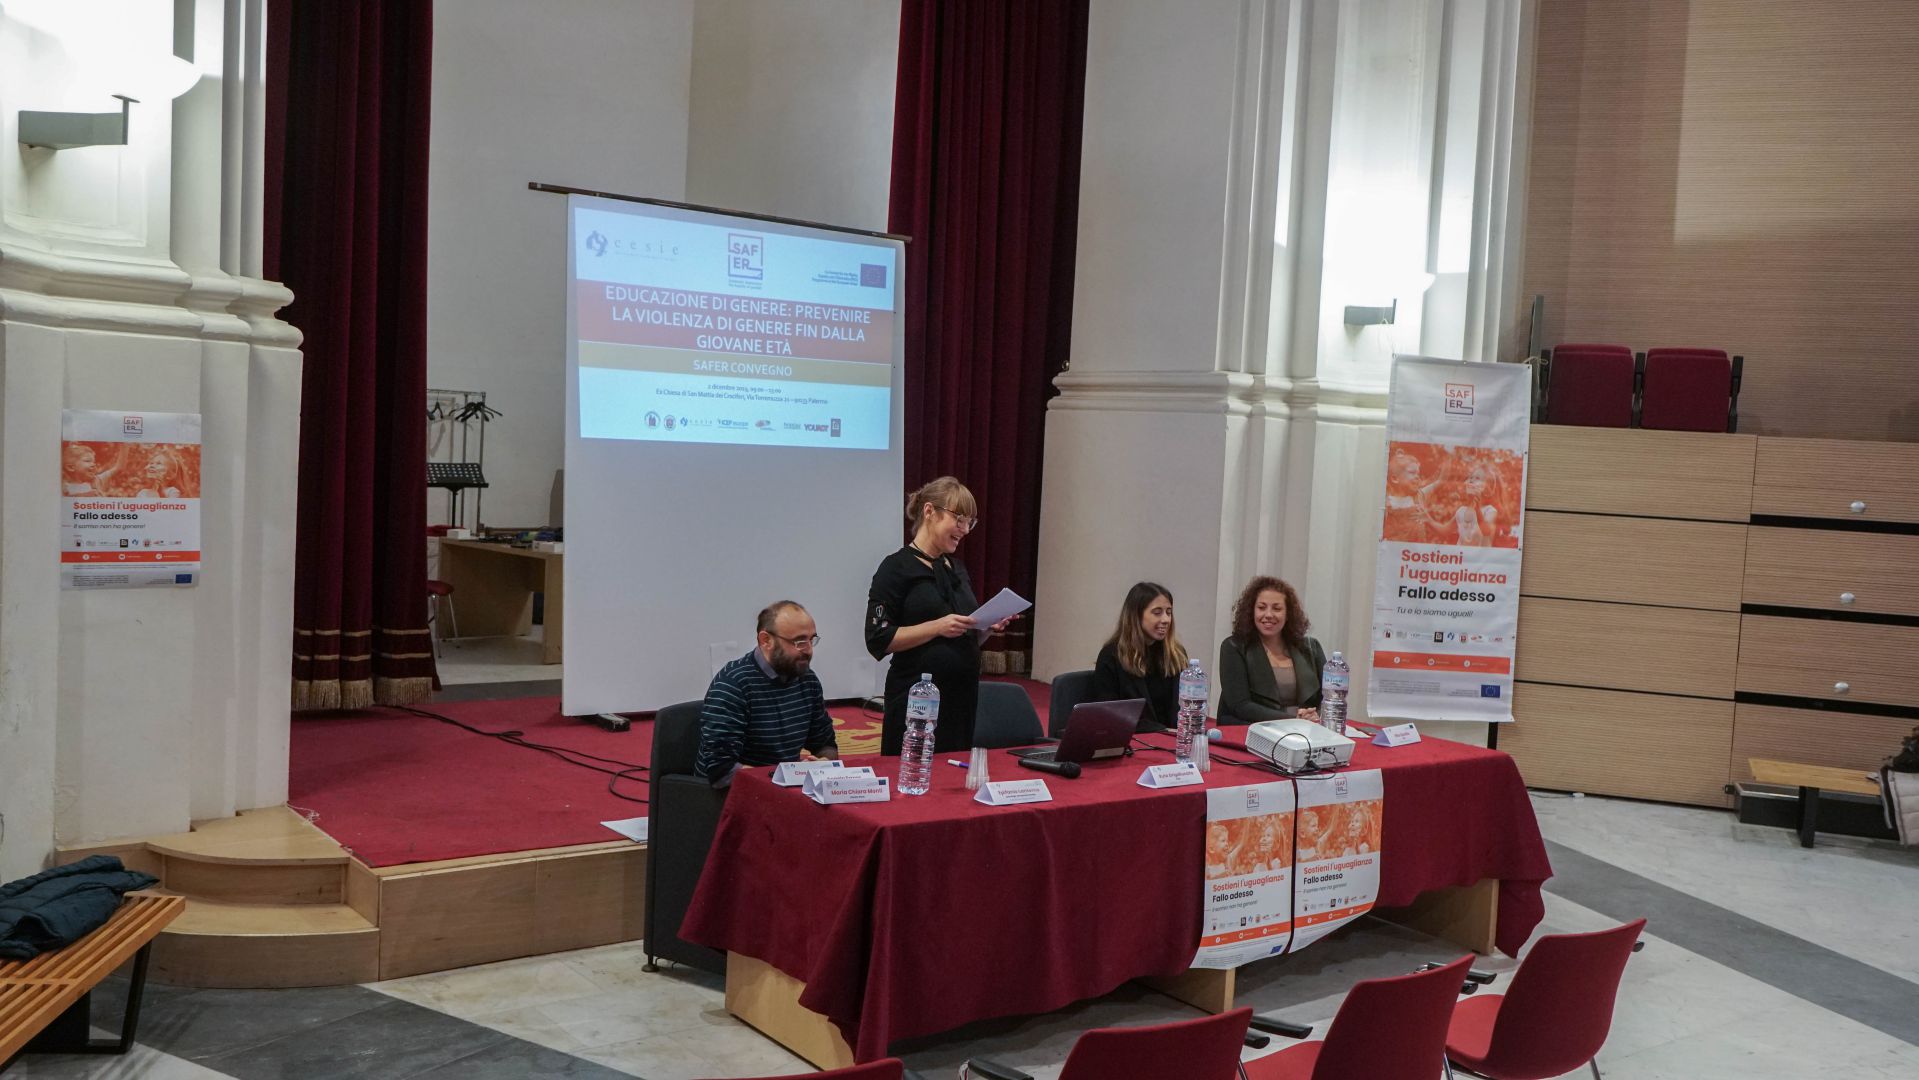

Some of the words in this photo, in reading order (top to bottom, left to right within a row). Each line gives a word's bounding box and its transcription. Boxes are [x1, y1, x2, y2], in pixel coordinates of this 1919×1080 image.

[733, 243, 758, 256] SAF
[733, 257, 750, 270] ER
[606, 285, 708, 309] EDUCAZIONE
[712, 296, 727, 311] DI
[730, 299, 792, 317] GENERE:
[795, 304, 872, 324] PREVENIRE
[612, 306, 633, 322] LA
[635, 308, 713, 329] VIOLENZA
[718, 316, 732, 331] DI
[735, 318, 792, 336] GENERE
[795, 323, 817, 338] FIN
[821, 325, 865, 342] DALLA
[696, 335, 762, 353] GIOVANE
[766, 339, 792, 355] ETÀ
[693, 360, 729, 372] SAFER
[731, 362, 792, 377] CONVEGNO
[1450, 389, 1470, 398] SAF
[1450, 400, 1463, 408] ER
[73, 502, 115, 510] Sostieni
[117, 501, 187, 512] l'uguaglianza
[73, 512, 99, 520] Fallo
[101, 512, 138, 520] adesso
[1401, 549, 1463, 565] Sostieni
[1400, 565, 1507, 585] l'uguaglianza
[1398, 585, 1437, 600] Fallo
[1440, 588, 1495, 603] adesso
[1397, 606, 1406, 614] Tu
[1423, 609, 1447, 617] siamo
[1303, 862, 1330, 874] Sostieni
[1303, 875, 1319, 885] Fallo
[1320, 872, 1343, 882] adesso
[1213, 880, 1240, 892] Sostieni
[1212, 893, 1229, 903] Fallo
[1229, 889, 1254, 900] adesso
